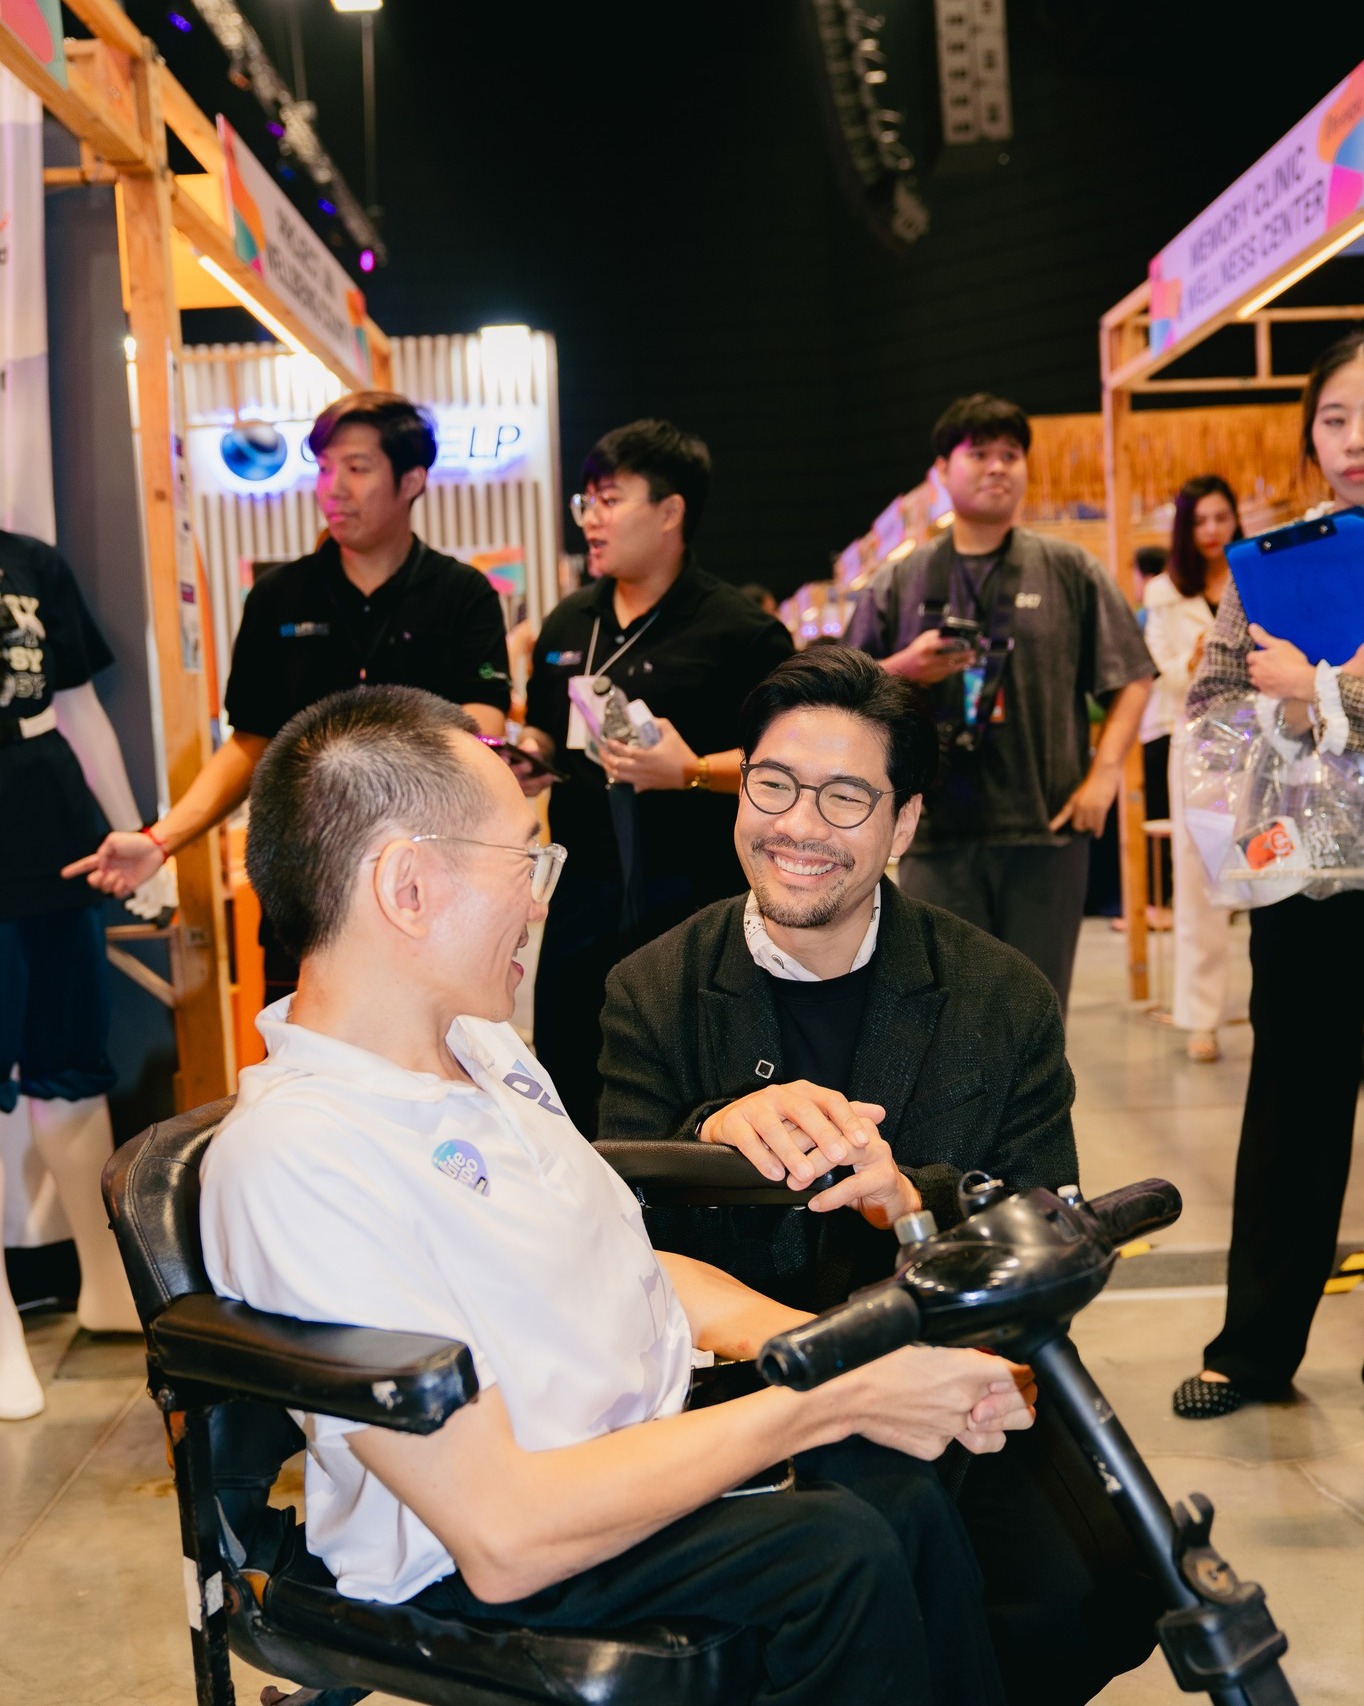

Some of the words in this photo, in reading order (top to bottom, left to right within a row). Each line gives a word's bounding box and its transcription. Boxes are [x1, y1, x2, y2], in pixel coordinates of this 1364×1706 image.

[1253, 143, 1306, 217] CLINIC
[1186, 233, 1257, 313] WELLNESS
[1260, 176, 1325, 257] CENTER
